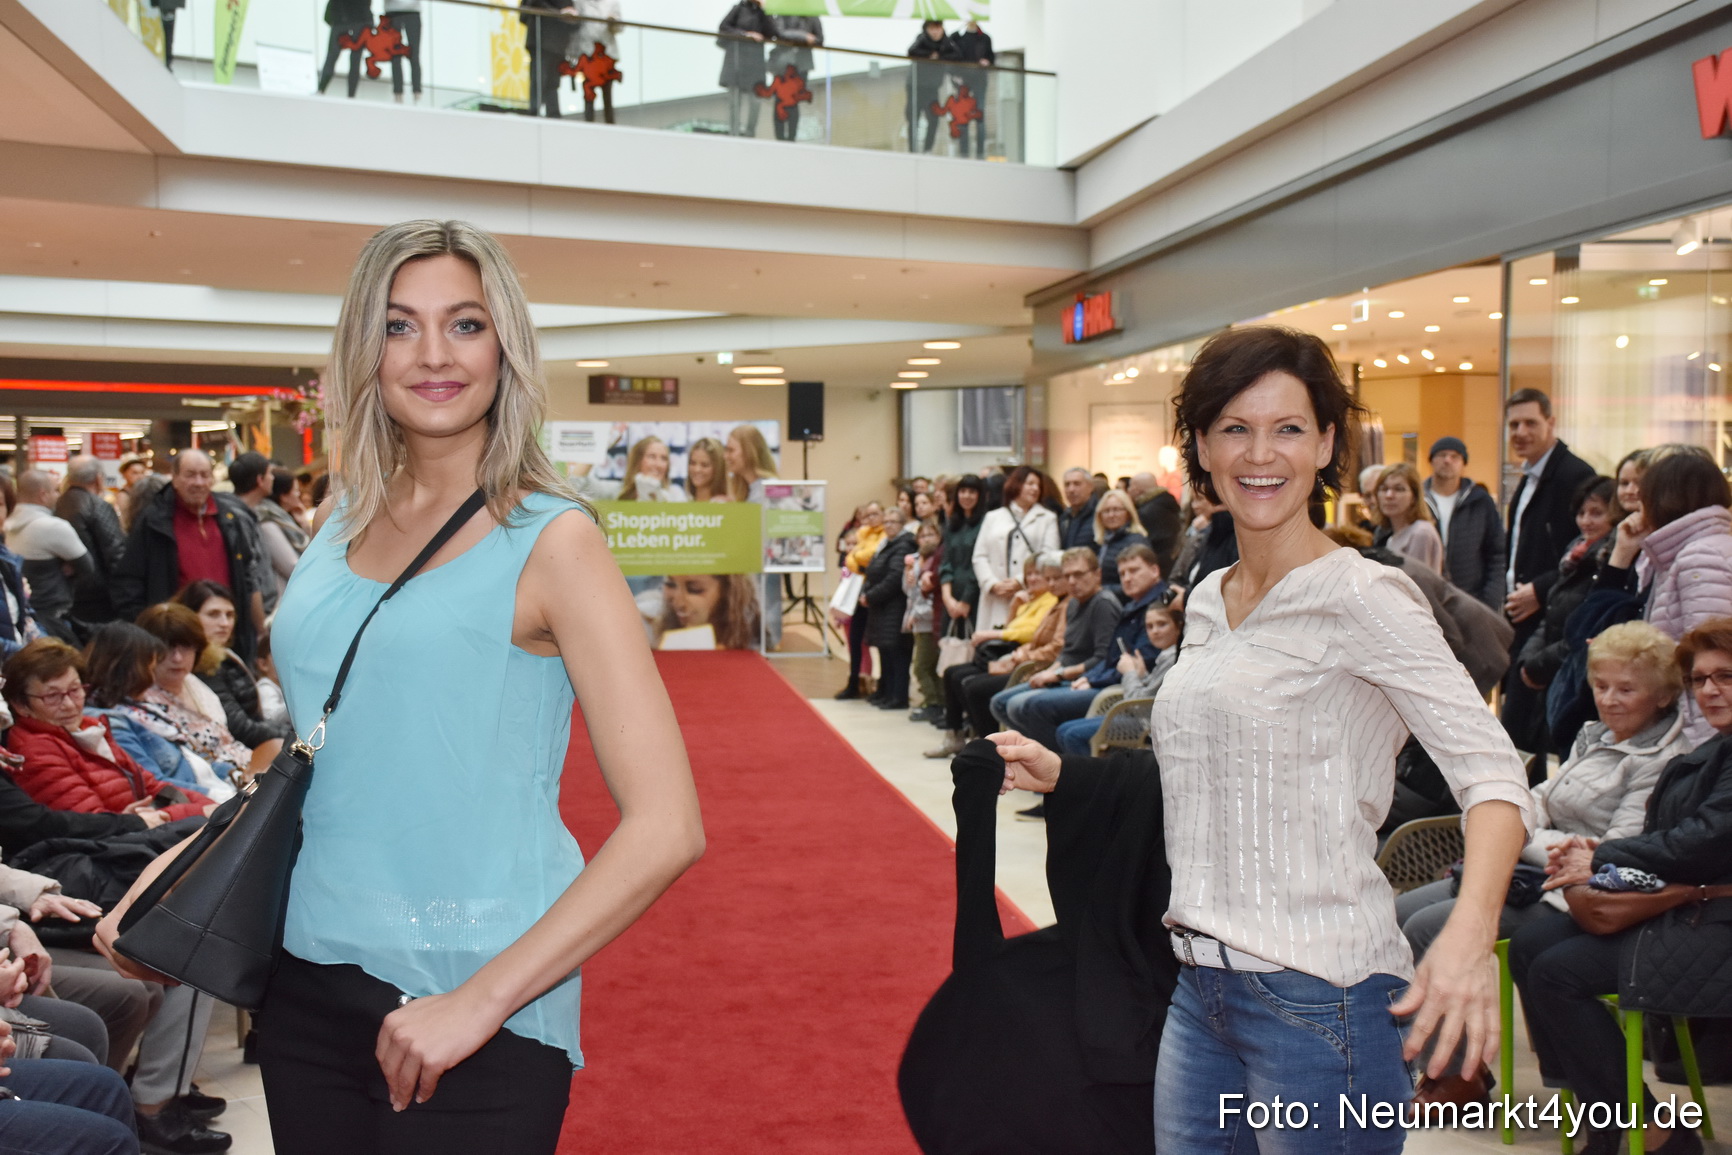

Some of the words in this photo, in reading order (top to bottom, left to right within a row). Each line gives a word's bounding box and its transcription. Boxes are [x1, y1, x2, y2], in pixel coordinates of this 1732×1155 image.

[607, 511, 724, 532] Shoppingtour
[617, 531, 671, 548] Leben
[672, 533, 706, 551] pur.
